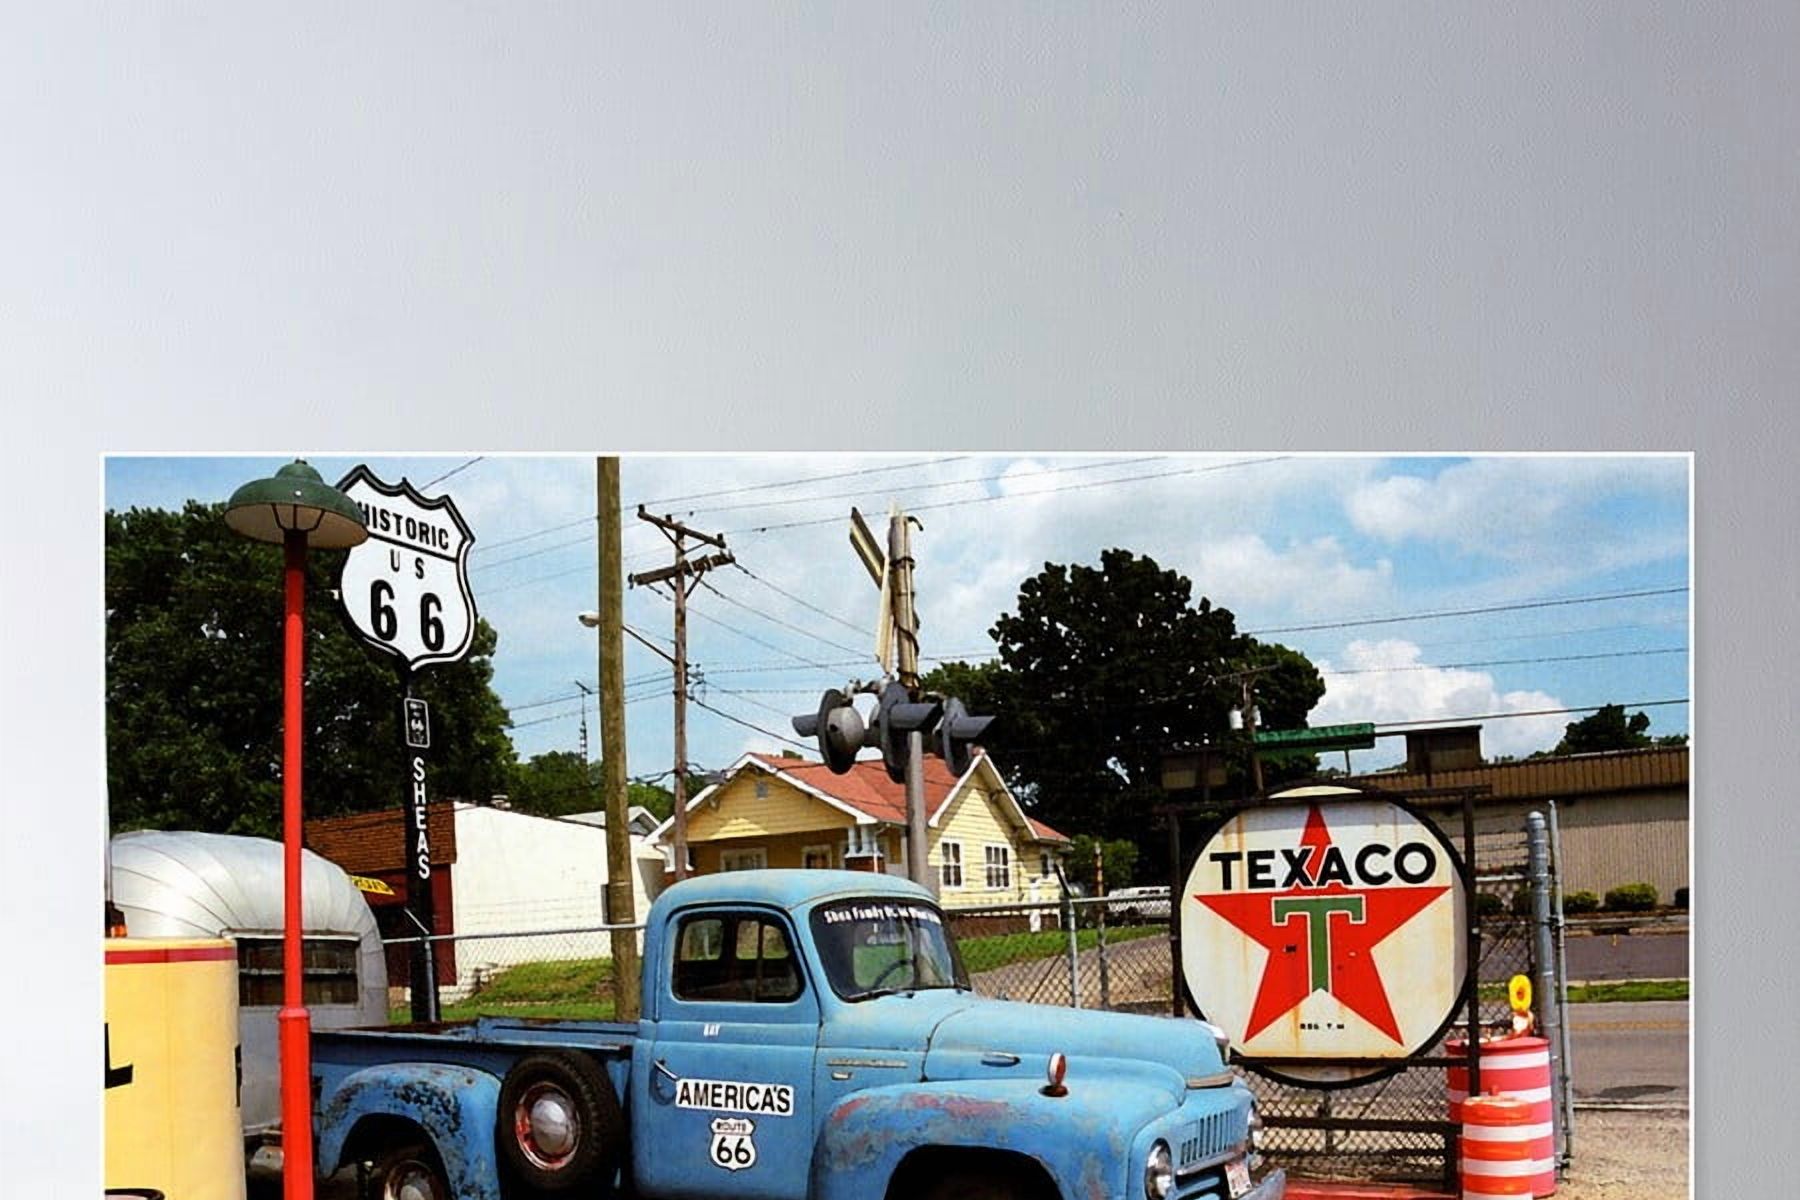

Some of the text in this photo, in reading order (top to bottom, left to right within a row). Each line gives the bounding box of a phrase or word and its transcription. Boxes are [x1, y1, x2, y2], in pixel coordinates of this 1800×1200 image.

[358, 502, 450, 550] HISTORIC
[370, 579, 445, 652] 66
[413, 756, 430, 880] SHEAS
[1209, 842, 1437, 891] TEXACO
[1272, 894, 1366, 994] T
[678, 1081, 790, 1114] AMERICA'S
[716, 1121, 747, 1133] ROUTE
[716, 1136, 751, 1165] 66
